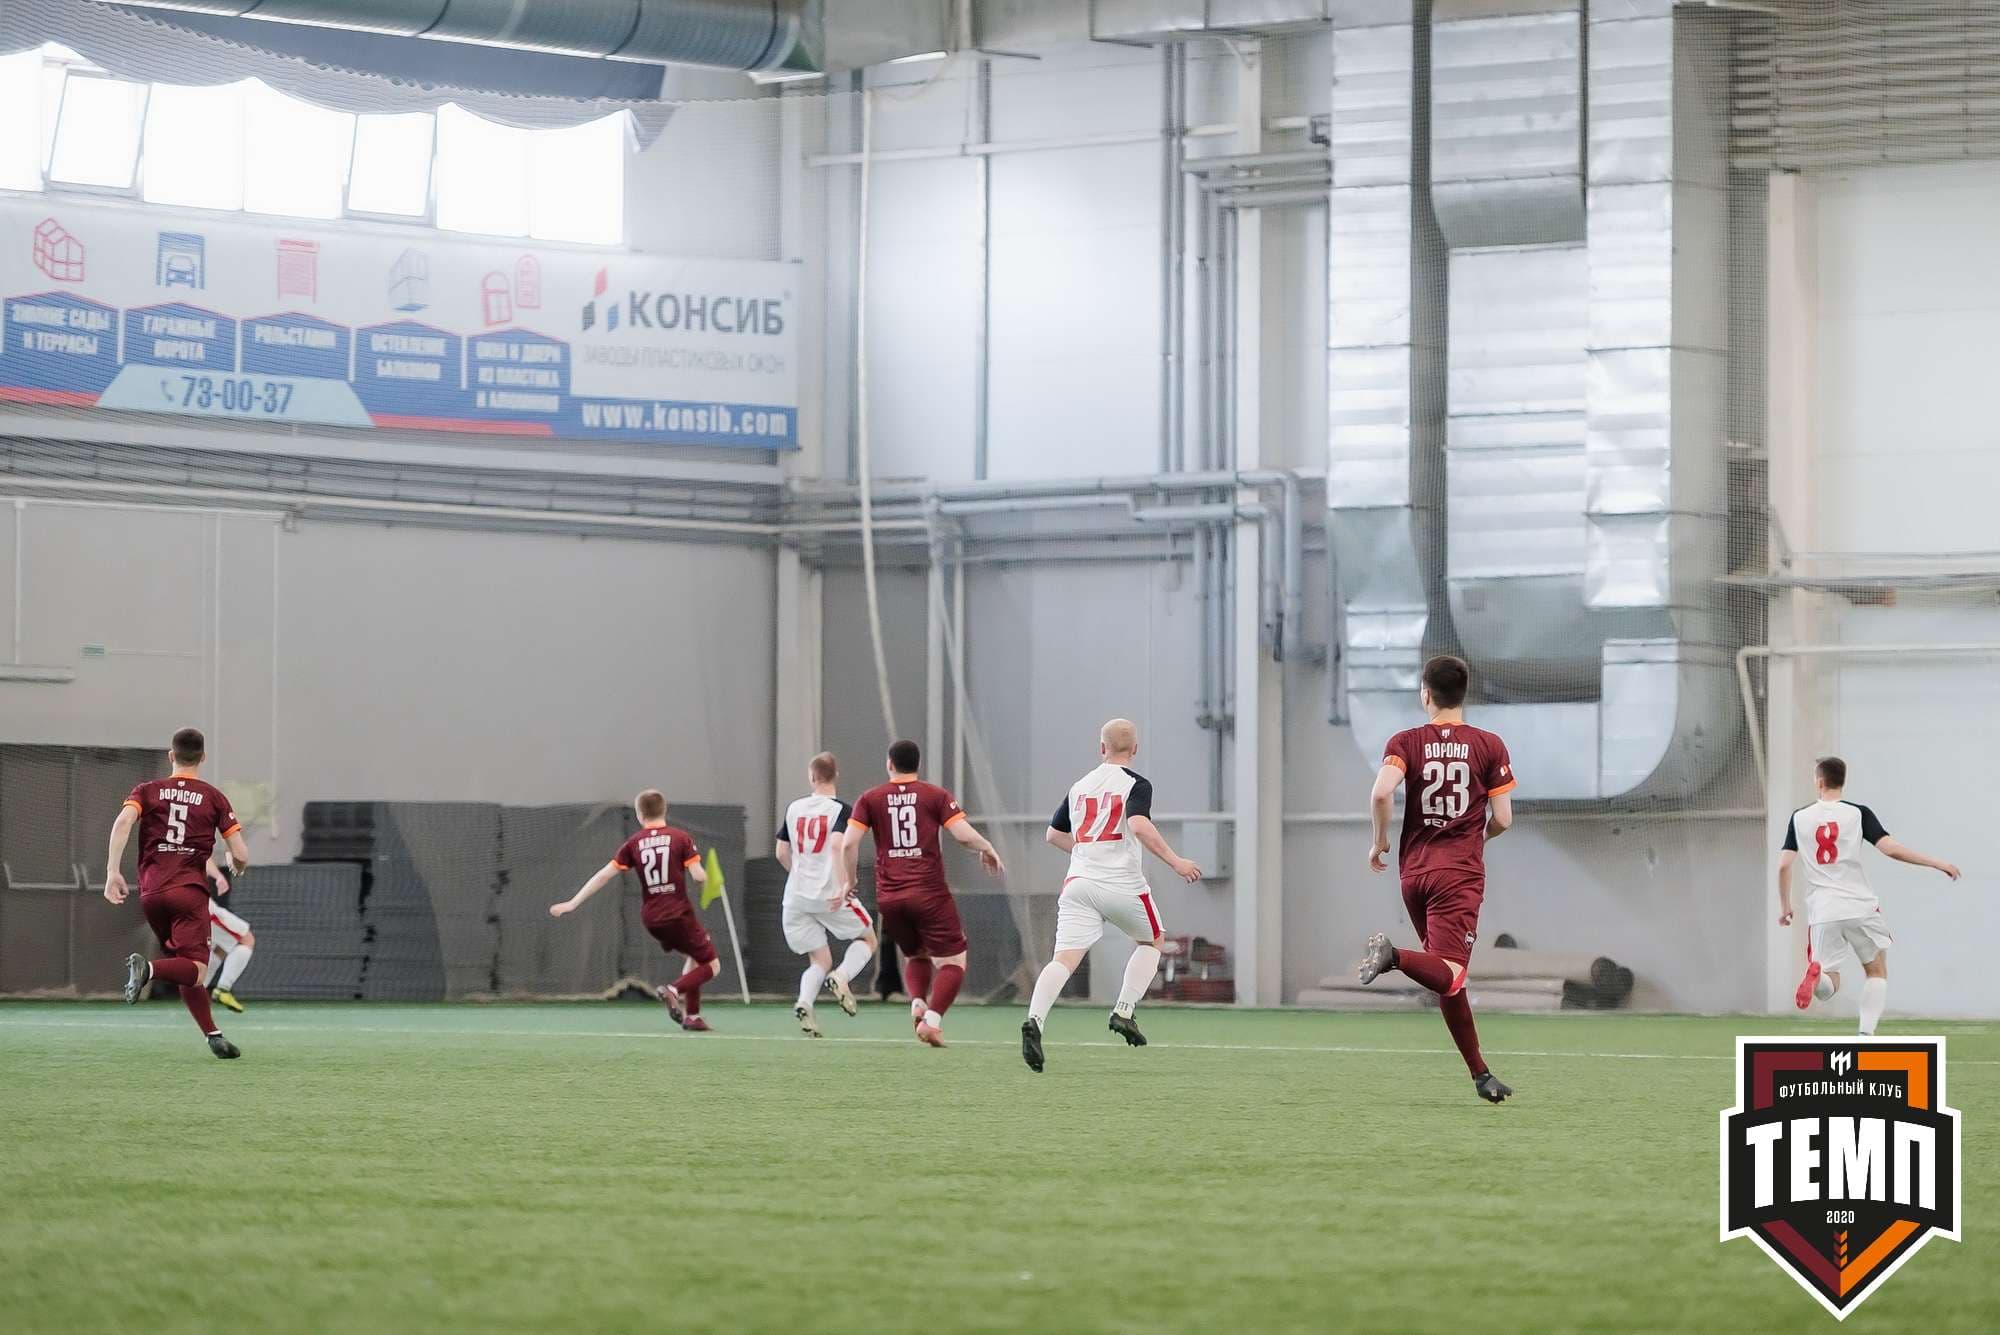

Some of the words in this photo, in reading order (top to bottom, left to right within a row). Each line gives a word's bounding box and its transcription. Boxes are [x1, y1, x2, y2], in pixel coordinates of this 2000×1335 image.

[629, 290, 785, 336] КОНСИБ
[37, 332, 99, 355] ТЕРРАСЫ
[181, 375, 293, 415] 73-00-37
[581, 402, 788, 437] www.konsib.com
[1424, 742, 1469, 760] ВОРОНА
[159, 788, 203, 806] БОРИСОВ
[1421, 760, 1470, 819] 23
[166, 802, 189, 845] 5
[795, 815, 828, 855] 19
[887, 805, 918, 848] 13
[1074, 791, 1123, 843] 22
[1815, 821, 1839, 866] 8
[641, 846, 670, 887] 27
